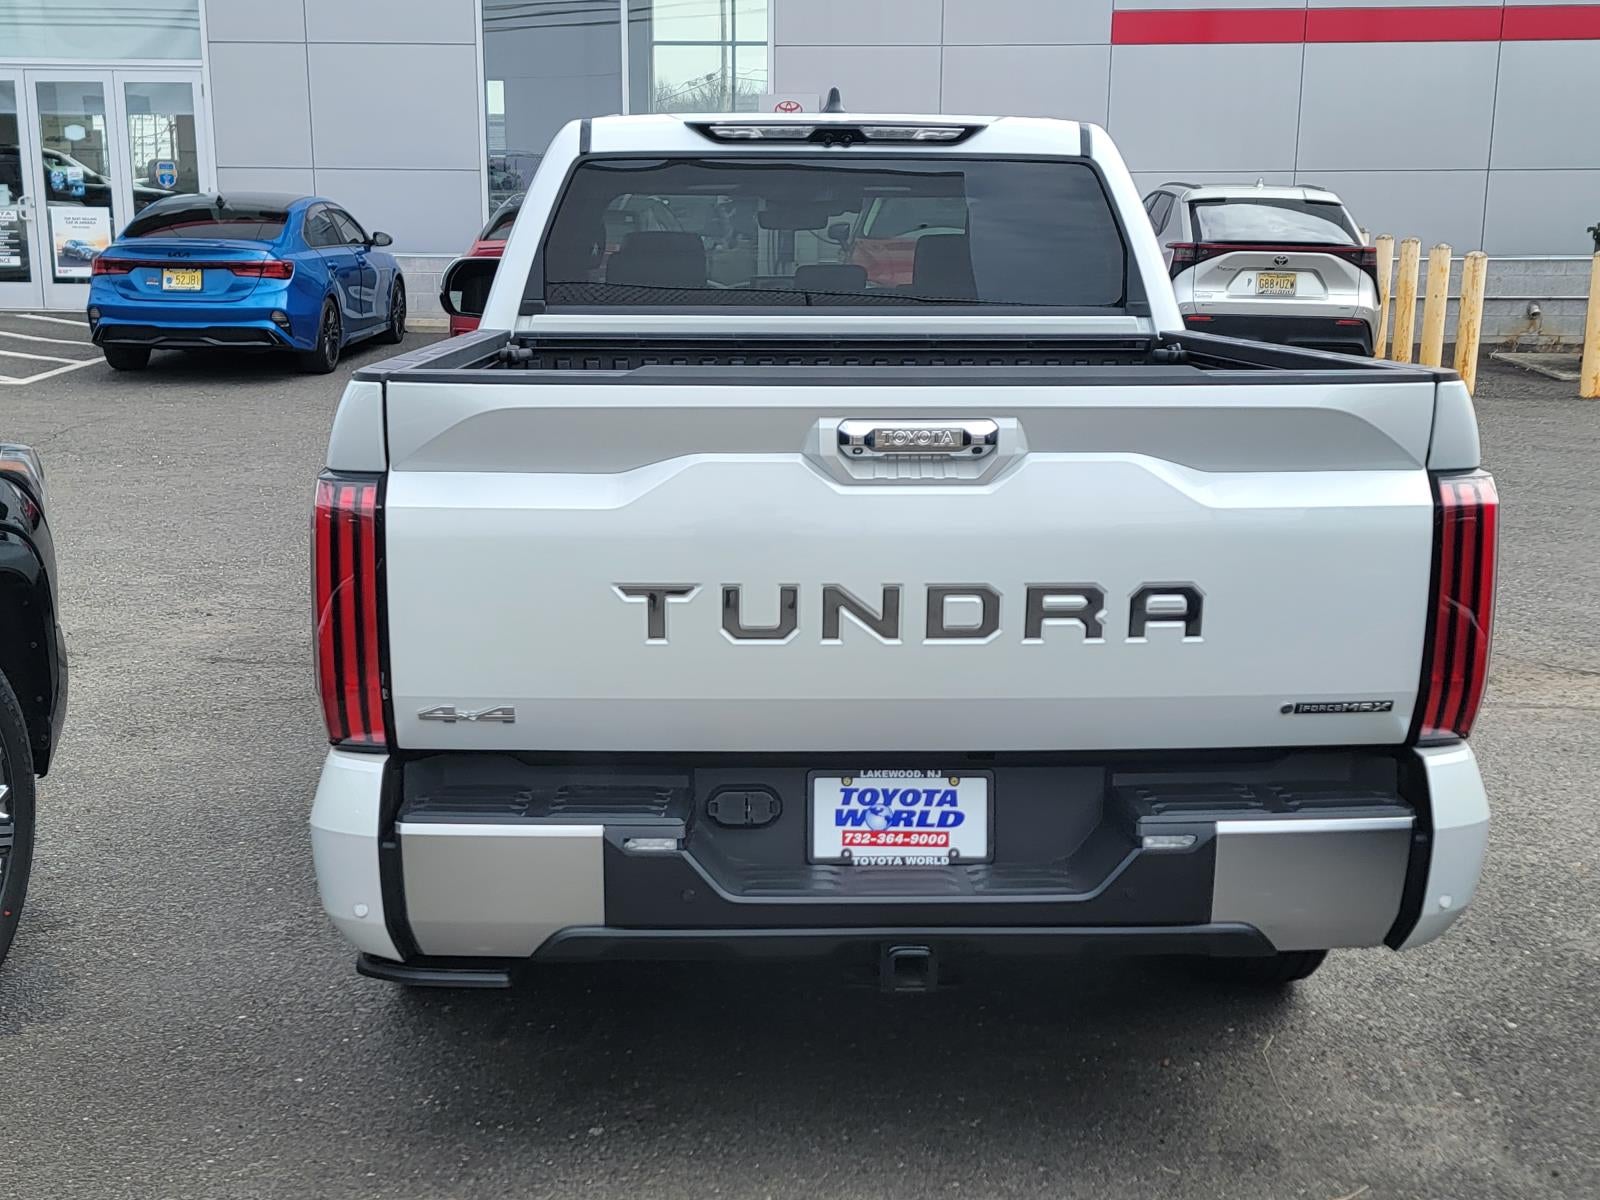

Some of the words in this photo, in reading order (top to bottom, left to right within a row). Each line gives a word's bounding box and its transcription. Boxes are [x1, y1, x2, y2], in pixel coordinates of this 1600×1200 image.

[881, 430, 955, 446] TOYOTA
[611, 581, 1206, 645] TUNDRA
[927, 770, 942, 779] NJ
[839, 787, 959, 807] TOYOTA
[835, 806, 966, 830] WORLD
[844, 832, 947, 845] 732-364-9000
[852, 856, 903, 866] TOYOTA
[904, 856, 950, 866] WORLD
